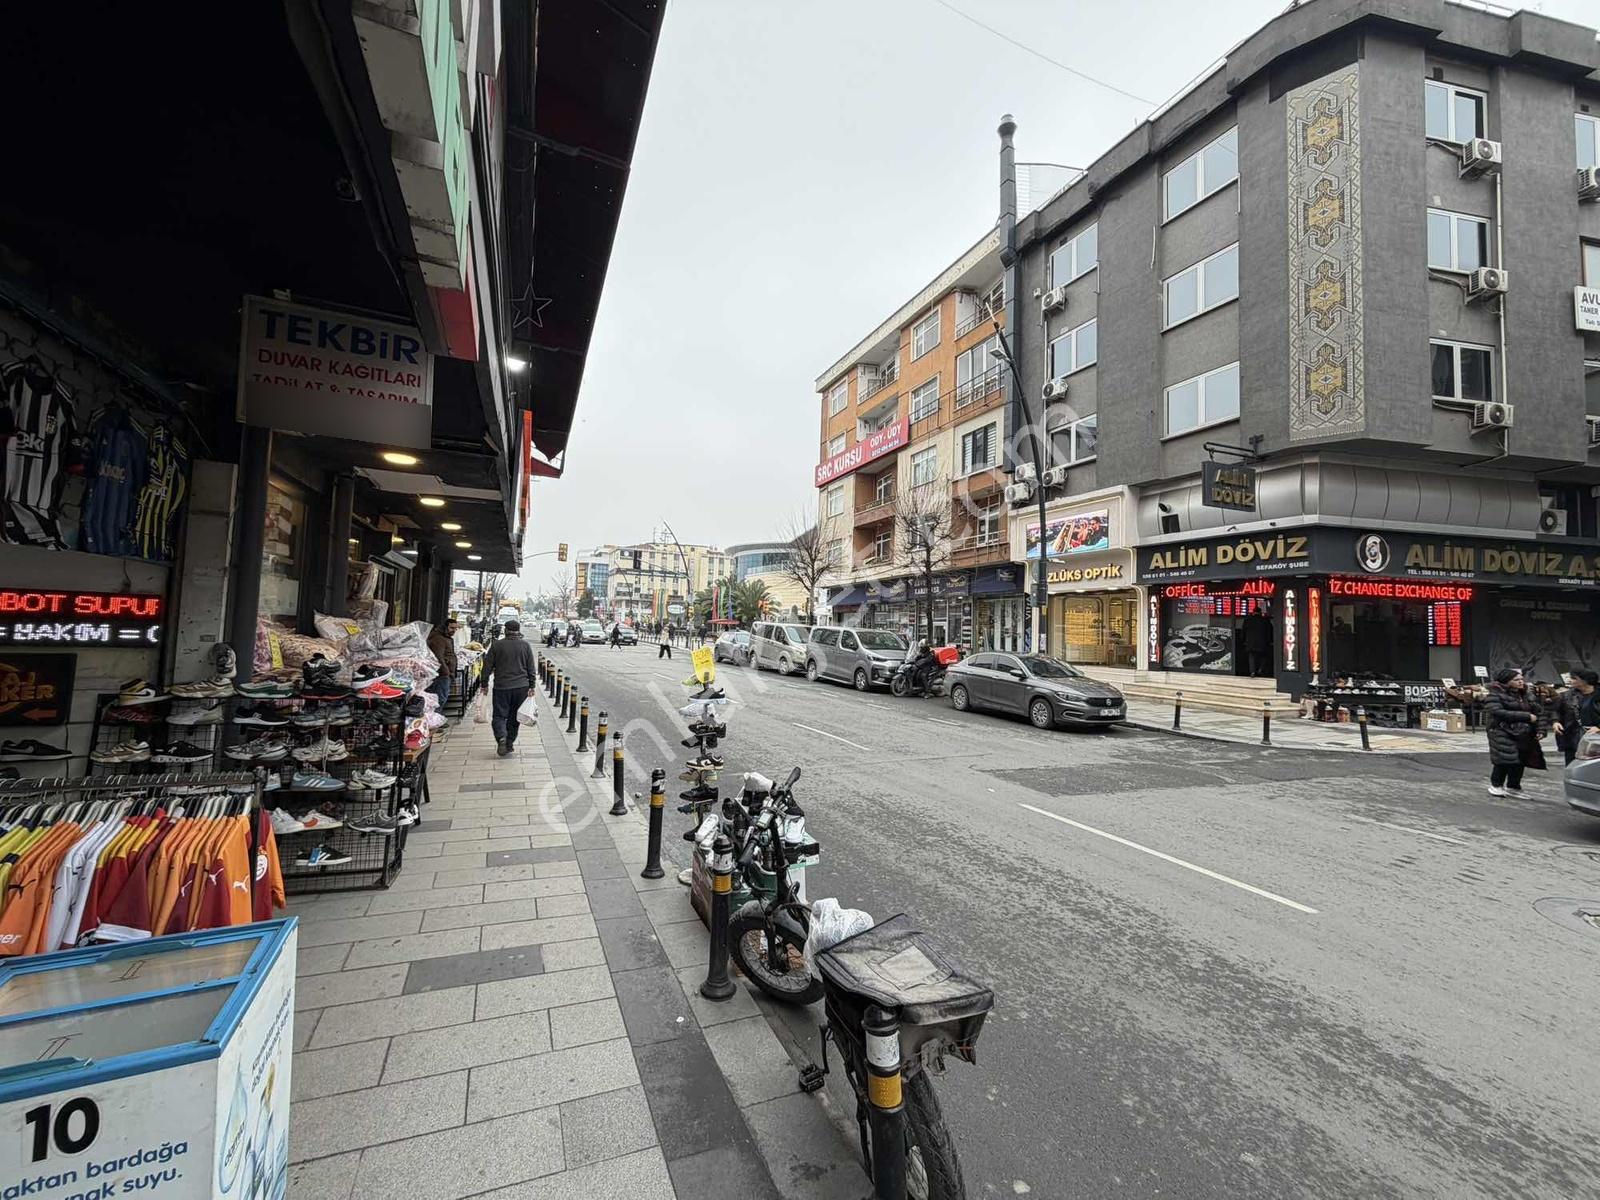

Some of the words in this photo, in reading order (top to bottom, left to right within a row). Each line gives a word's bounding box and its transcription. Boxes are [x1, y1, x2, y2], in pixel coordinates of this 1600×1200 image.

[258, 349, 322, 372] DUVAR
[817, 464, 833, 482] SRC
[833, 445, 863, 475] KURSU
[1149, 545, 1208, 570] ALİM
[1216, 534, 1309, 564] DÖVİZ
[1288, 561, 1310, 569] ŞUBE
[1405, 541, 1475, 571] ALİM
[1482, 545, 1564, 576] DÖVİZ
[1047, 568, 1082, 583] ZLÜKS
[1084, 564, 1121, 579] OPTİK
[1344, 582, 1393, 597] CHANGE
[1395, 584, 1454, 600] EXCHANGE
[1457, 588, 1472, 601] OF
[25, 1096, 100, 1163] 10
[0, 1170, 78, 1200] aktan
[86, 1142, 188, 1179] bardağa
[123, 1168, 183, 1193] suyu.
